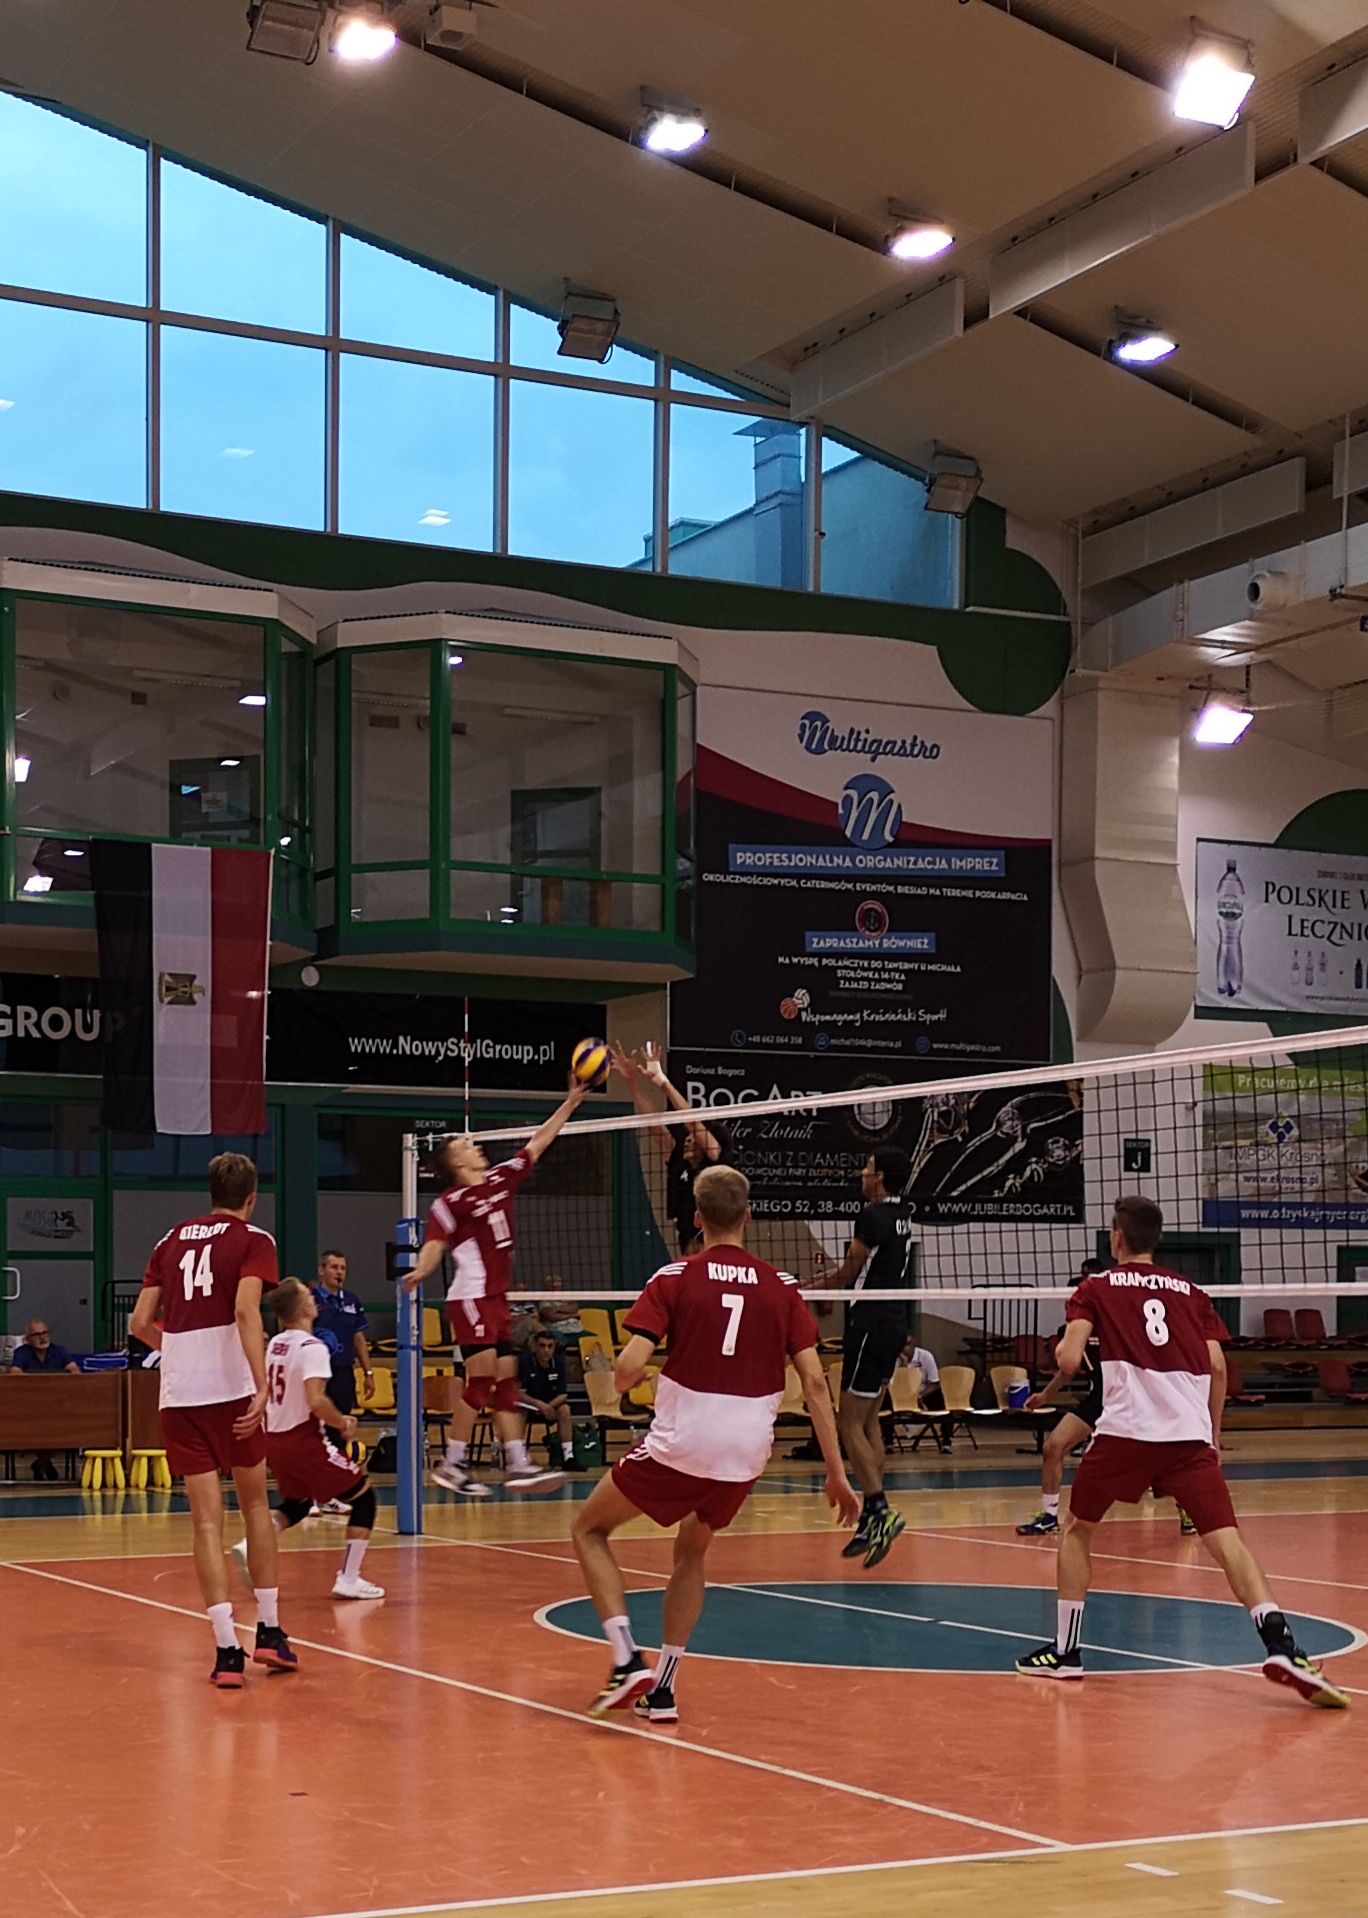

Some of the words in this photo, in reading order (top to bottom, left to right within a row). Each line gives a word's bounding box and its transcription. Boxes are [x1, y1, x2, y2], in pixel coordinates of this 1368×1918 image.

[799, 716, 941, 763] Multigastro
[736, 851, 852, 868] PROFESJONALNA
[855, 854, 948, 871] ORGANIZACJA
[951, 857, 999, 871] IMPREZ
[896, 885, 928, 895] BIESIAD
[929, 886, 941, 896] NA
[942, 888, 974, 898] TERENIE
[975, 889, 1029, 902] PODKARPACIA
[1264, 880, 1352, 916] POLSKIE
[812, 938, 881, 949] ZAPRASZAMY
[883, 937, 929, 949] RÓWNIEŻ
[777, 956, 790, 964] NA
[871, 960, 883, 969] DO
[884, 960, 919, 971] TAWERNY
[348, 1035, 555, 1064] www.NowyStylGroup.pl
[685, 1064, 716, 1075] Dariusz
[1238, 1074, 1306, 1094] Pracujemy
[415, 1119, 447, 1129] SEKTOR
[786, 1151, 794, 1166] Z
[1230, 1147, 1276, 1162] MPGK
[1280, 1149, 1327, 1163] Krosno
[794, 1200, 814, 1215] 52,
[817, 1201, 861, 1214] 38-400
[937, 1201, 1076, 1217] WWW.JUBILERBOGART.PL
[179, 1243, 214, 1301] 14
[707, 1261, 758, 1285] KUPKA
[722, 1293, 745, 1356] 7
[1143, 1298, 1169, 1347] 8
[268, 1363, 286, 1406] 15
